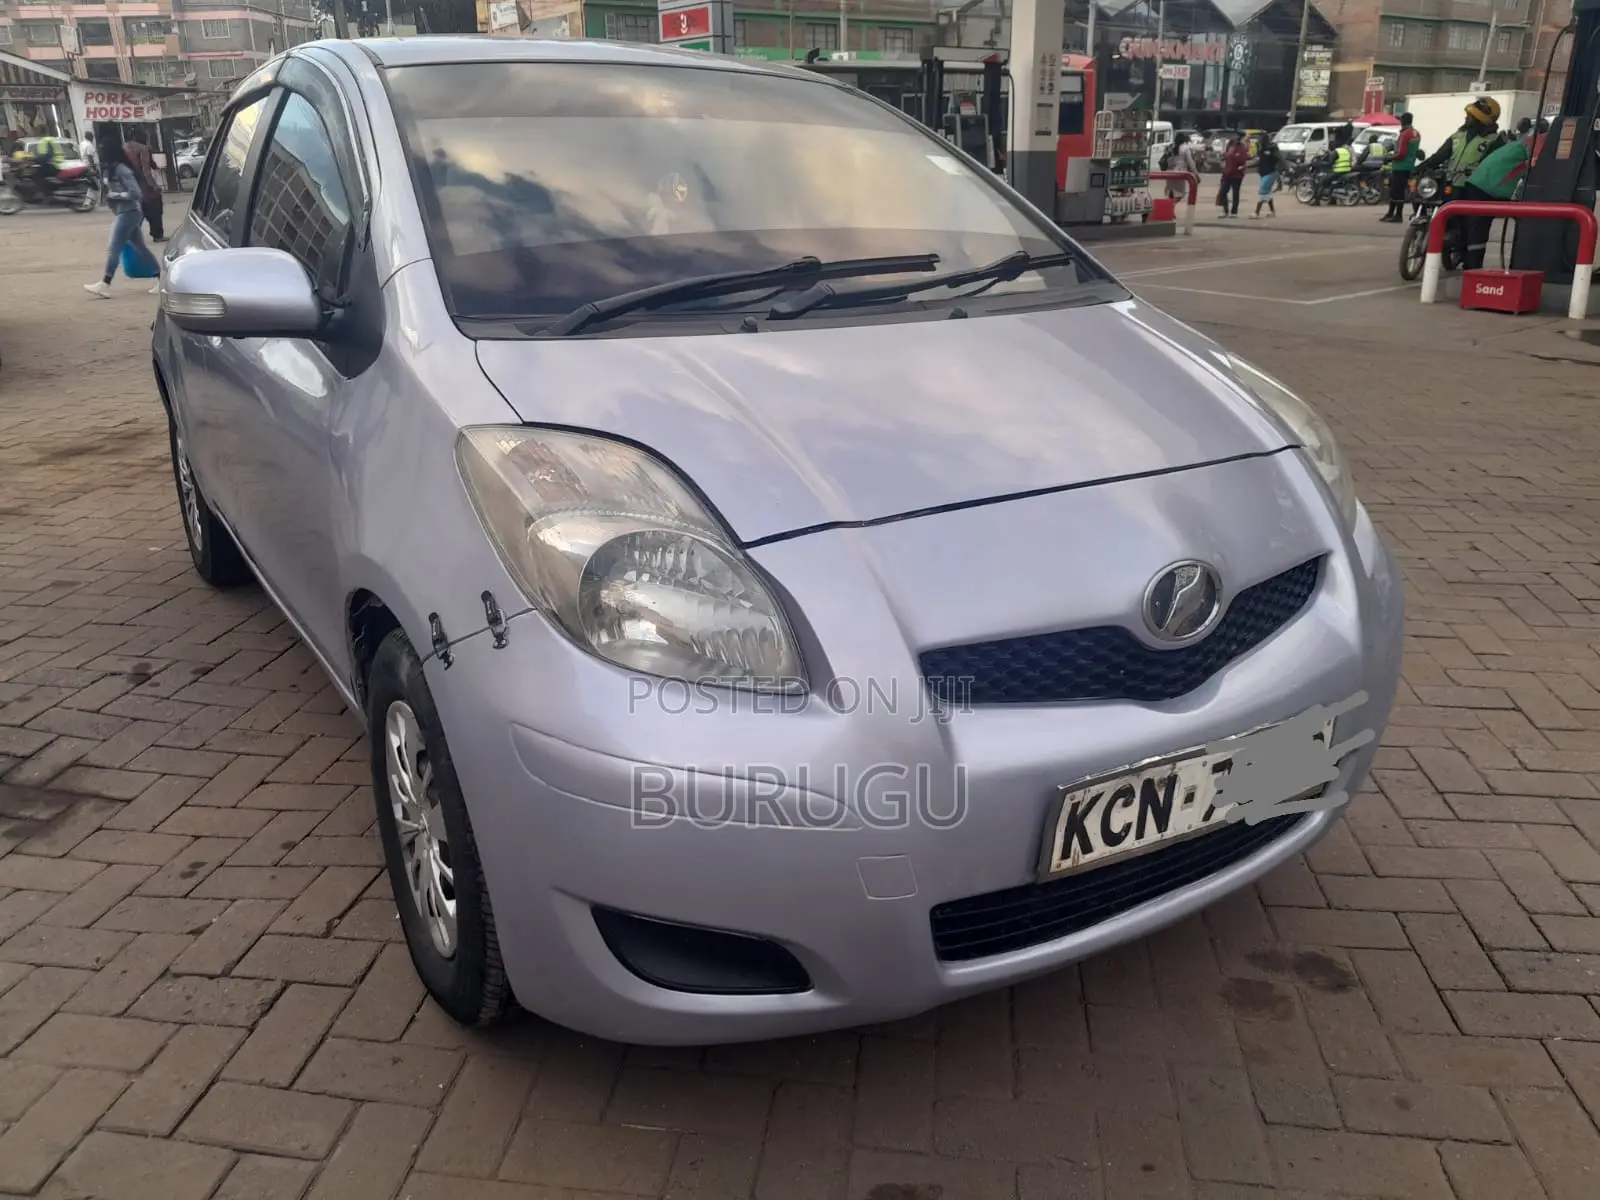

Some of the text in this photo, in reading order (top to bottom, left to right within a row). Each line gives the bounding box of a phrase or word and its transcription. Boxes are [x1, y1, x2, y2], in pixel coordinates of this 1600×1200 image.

[84, 92, 136, 105] PORK
[85, 106, 145, 119] HOUSE
[1475, 283, 1504, 296] Sand
[1061, 775, 1178, 860] KCN
